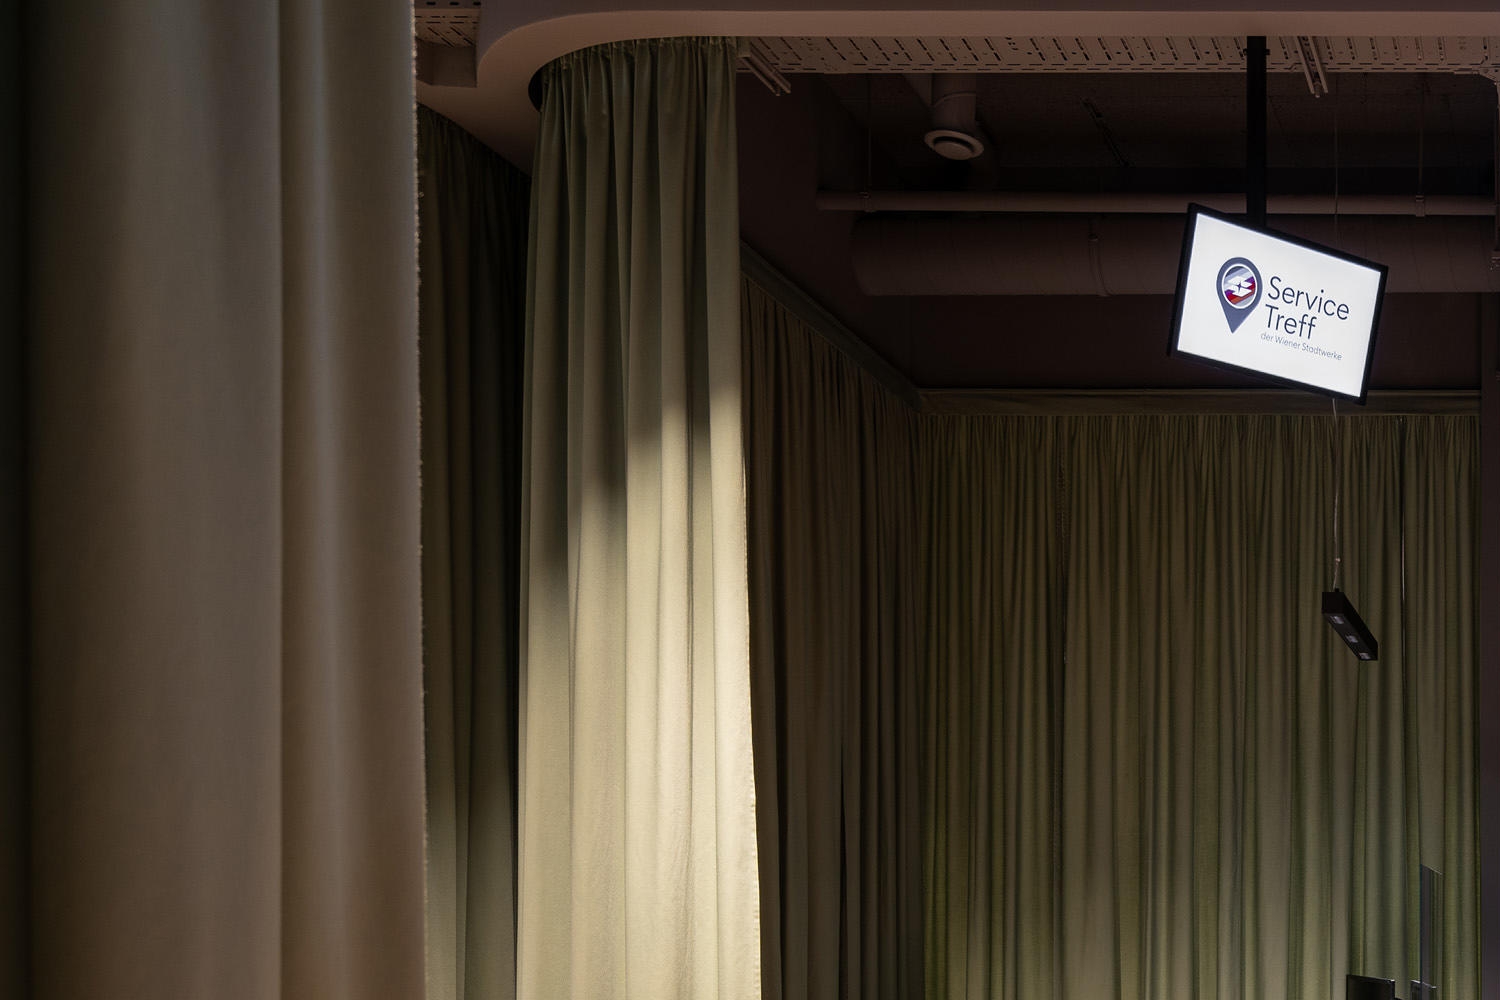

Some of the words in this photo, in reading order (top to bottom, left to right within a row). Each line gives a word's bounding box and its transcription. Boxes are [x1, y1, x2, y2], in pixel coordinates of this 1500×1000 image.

[1267, 276, 1349, 320] Service
[1265, 304, 1317, 340] Treff
[1260, 332, 1273, 342] der
[1274, 335, 1301, 350] Wiener
[1301, 342, 1342, 361] Stadtwerke
